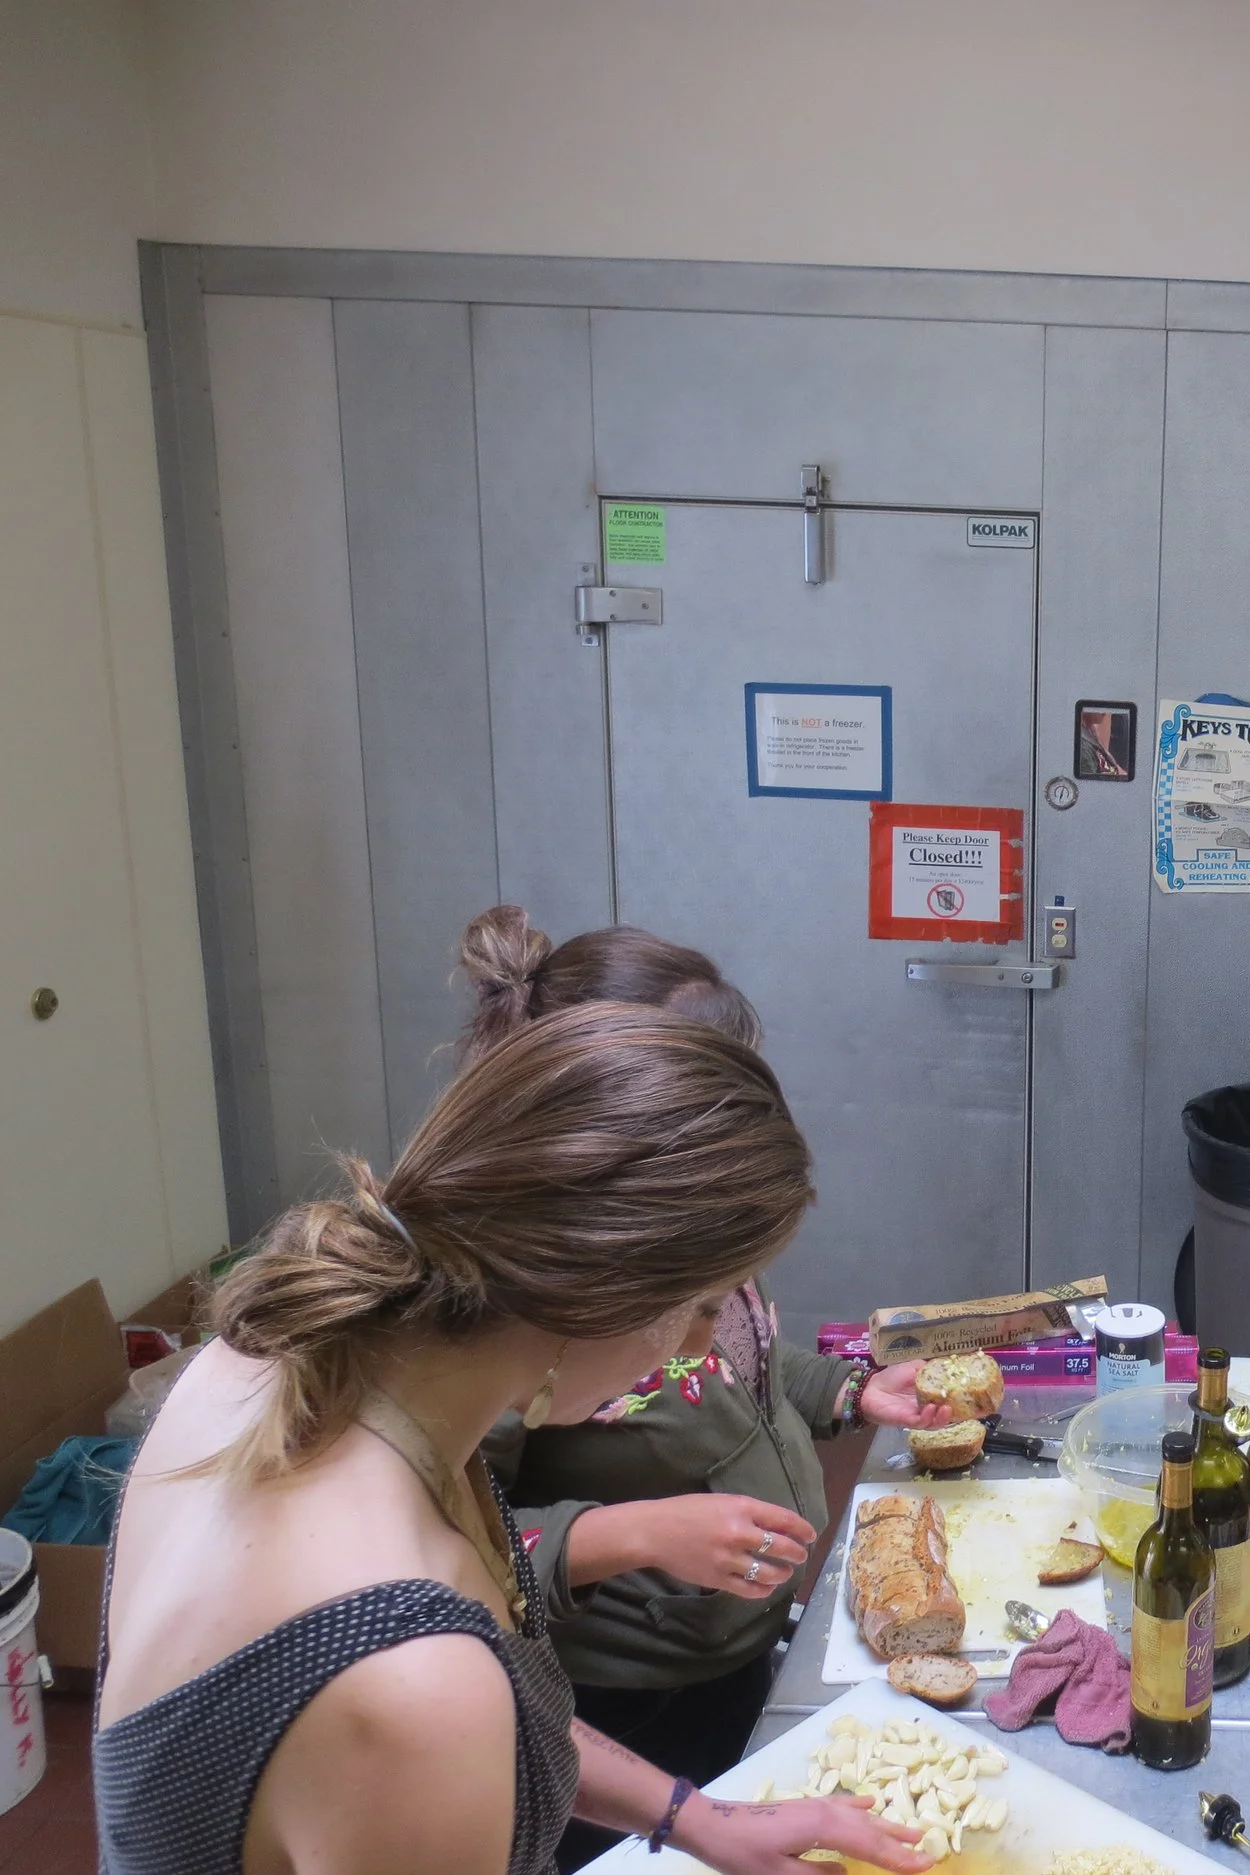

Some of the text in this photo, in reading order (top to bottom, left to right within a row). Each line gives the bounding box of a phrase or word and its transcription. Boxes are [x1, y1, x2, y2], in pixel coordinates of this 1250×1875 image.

[613, 510, 659, 520] ATTENTION
[972, 523, 1029, 537] KOLPAK
[771, 716, 790, 726] This
[791, 717, 799, 726] is
[801, 718, 822, 728] NOT
[832, 719, 865, 728] freezer.
[1180, 719, 1232, 741] KEYS
[903, 832, 989, 846] Please Keep Door
[909, 848, 982, 865] Closed!!!
[1182, 862, 1229, 870] COOLING
[1189, 873, 1247, 881] REHEATING
[933, 1324, 998, 1341] 100% Recycled
[932, 1335, 1004, 1354] Aluminum
[1108, 1352, 1137, 1360] MORTON
[1000, 1363, 1035, 1372] inum Foil
[1066, 1358, 1089, 1369] 37.5
[1107, 1361, 1141, 1370] NATURAL
[1108, 1368, 1139, 1377] SEA SALT
